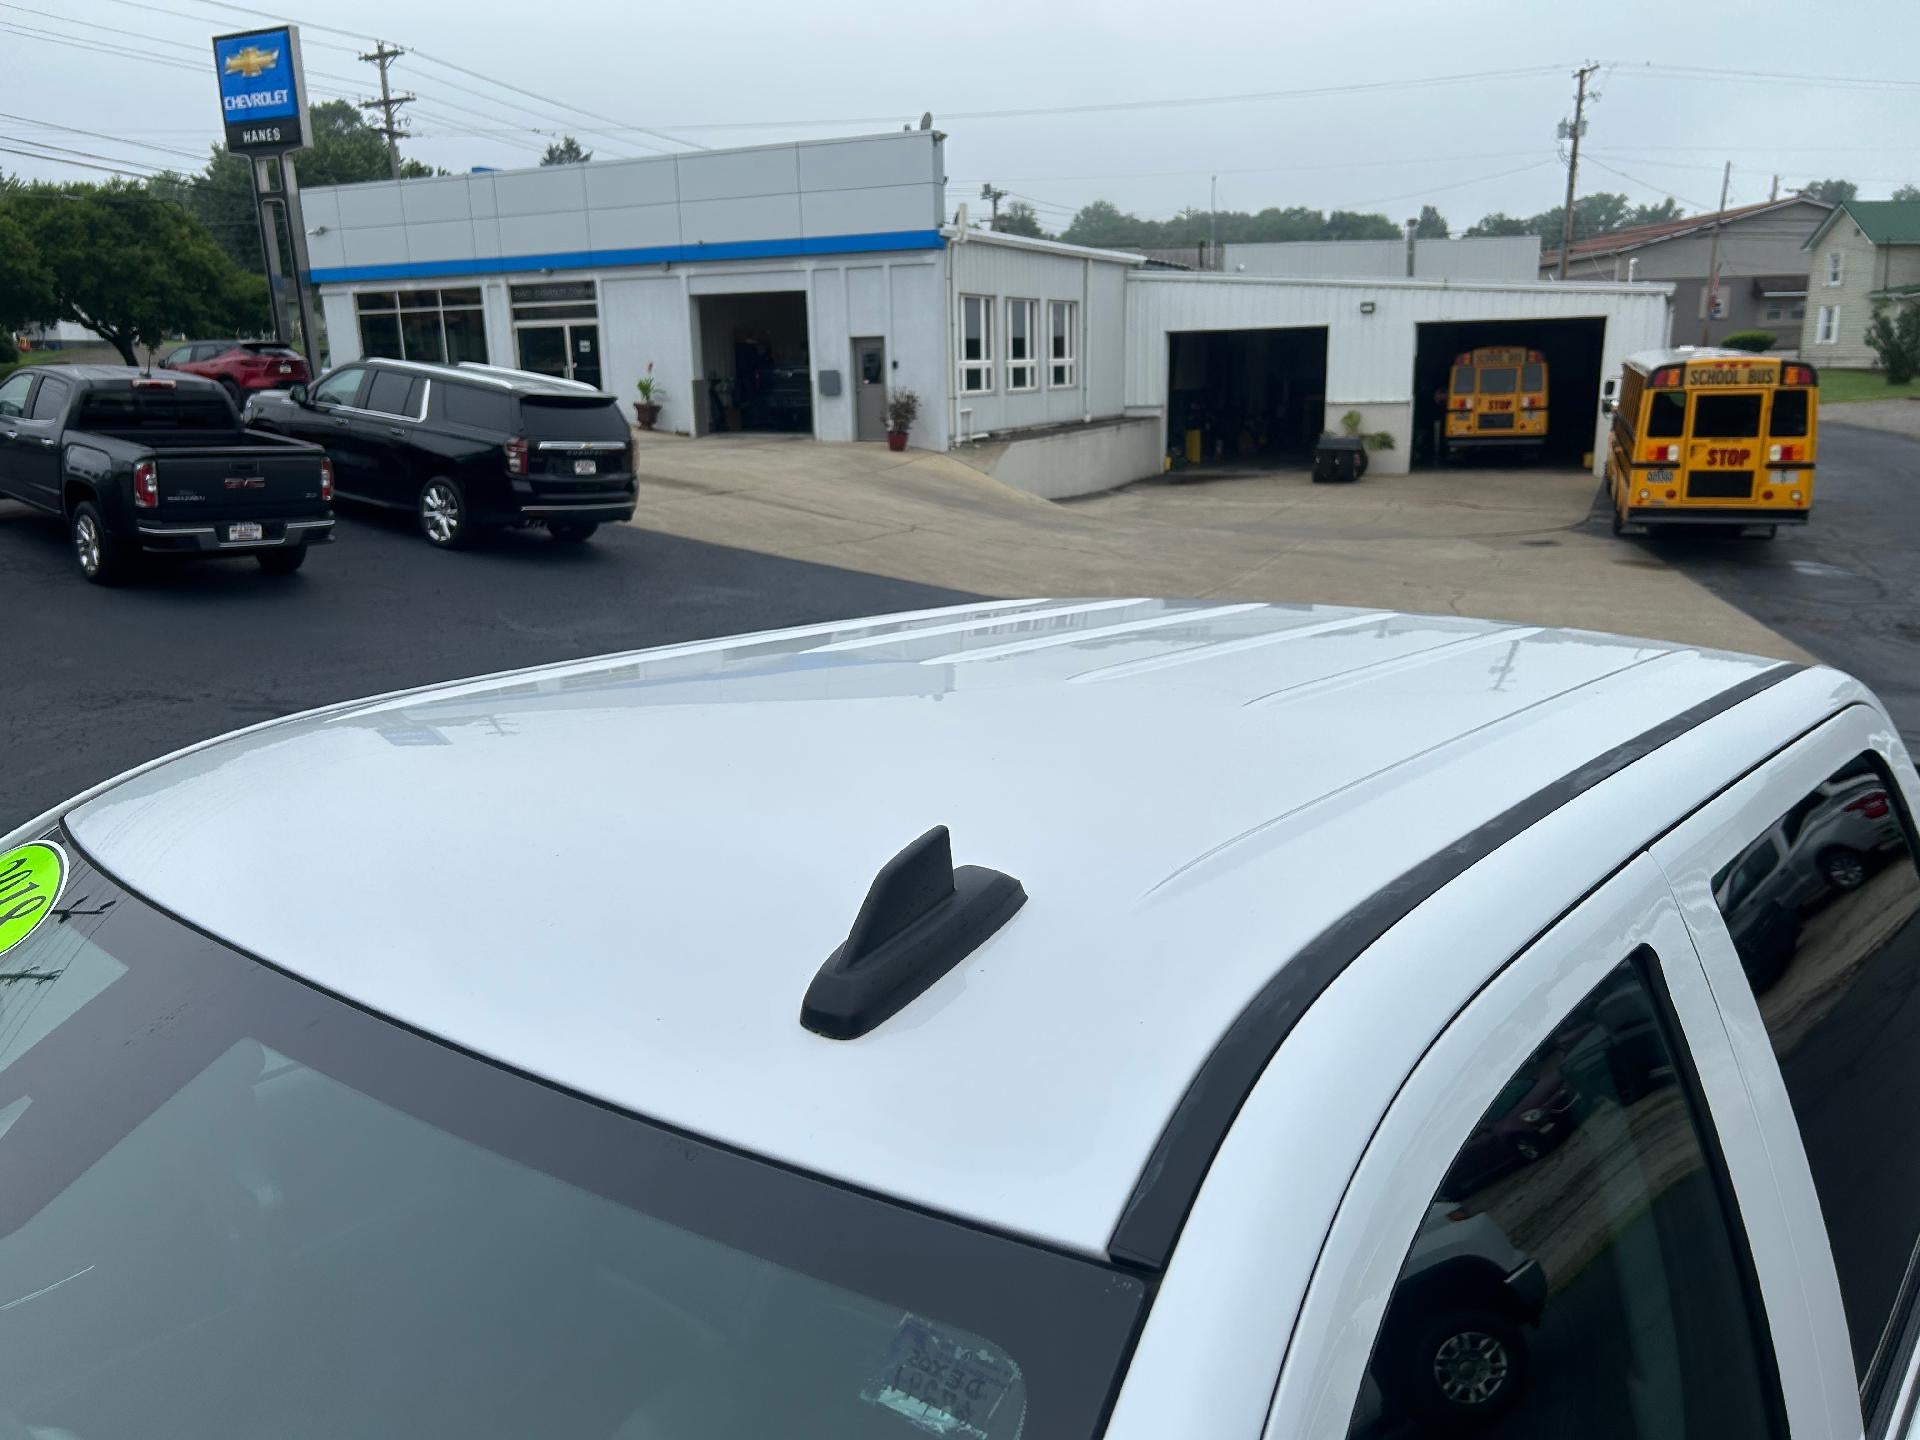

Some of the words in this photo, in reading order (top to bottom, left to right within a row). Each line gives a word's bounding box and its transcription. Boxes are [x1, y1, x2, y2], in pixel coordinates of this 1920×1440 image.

[224, 89, 288, 111] CHEVROLET
[242, 127, 281, 143] HANES
[1690, 369, 1740, 385] SCHOOL
[1747, 368, 1775, 384] BUS
[1488, 400, 1513, 411] STOP
[1706, 448, 1751, 468] STOP
